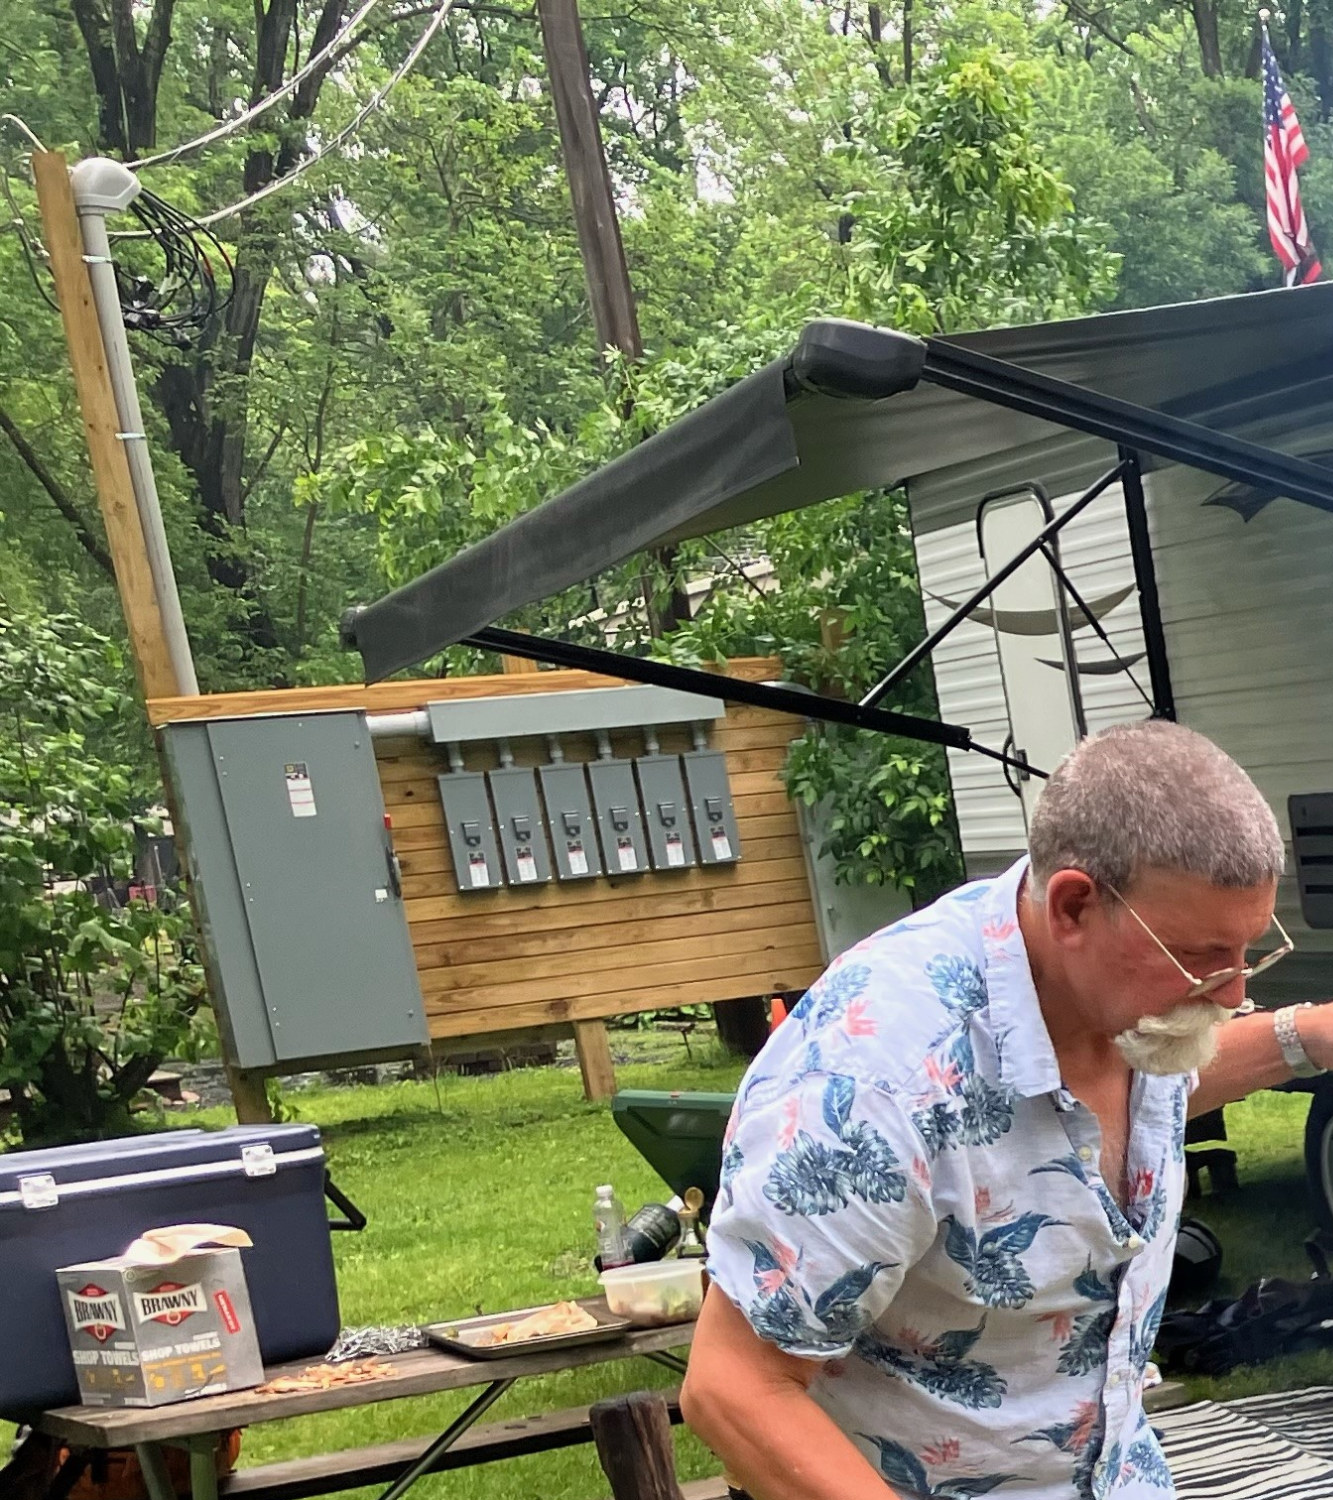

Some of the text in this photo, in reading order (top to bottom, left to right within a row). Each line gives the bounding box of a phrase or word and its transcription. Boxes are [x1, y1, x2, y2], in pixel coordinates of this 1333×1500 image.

[74, 1299, 118, 1323] BRAWNY
[141, 1288, 199, 1317] BRAWNY
[72, 1350, 99, 1365] SHOP
[101, 1351, 140, 1366] TOWELS
[142, 1344, 174, 1362] SHOP
[174, 1338, 222, 1355] TOWELS
